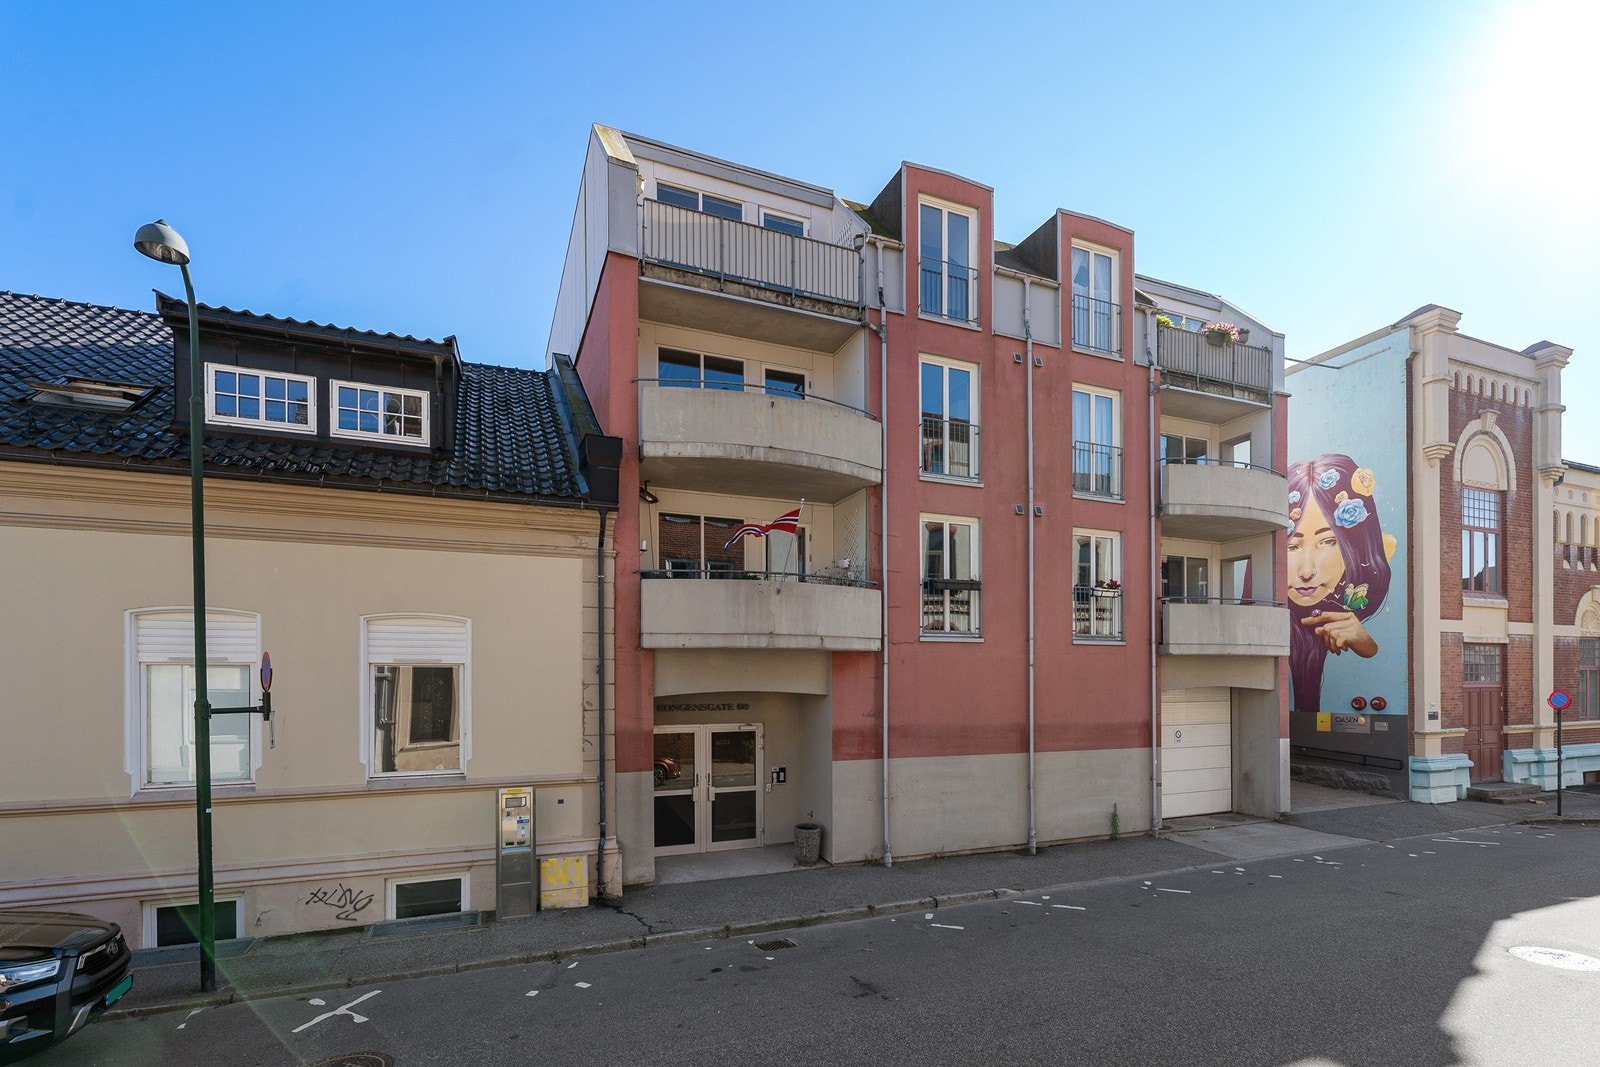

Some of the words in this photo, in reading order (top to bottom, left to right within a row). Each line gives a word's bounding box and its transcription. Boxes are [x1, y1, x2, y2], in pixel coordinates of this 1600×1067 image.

[656, 703, 734, 712] KONGENSGATE
[737, 703, 750, 711] 60
[1335, 716, 1359, 724] OASEN
